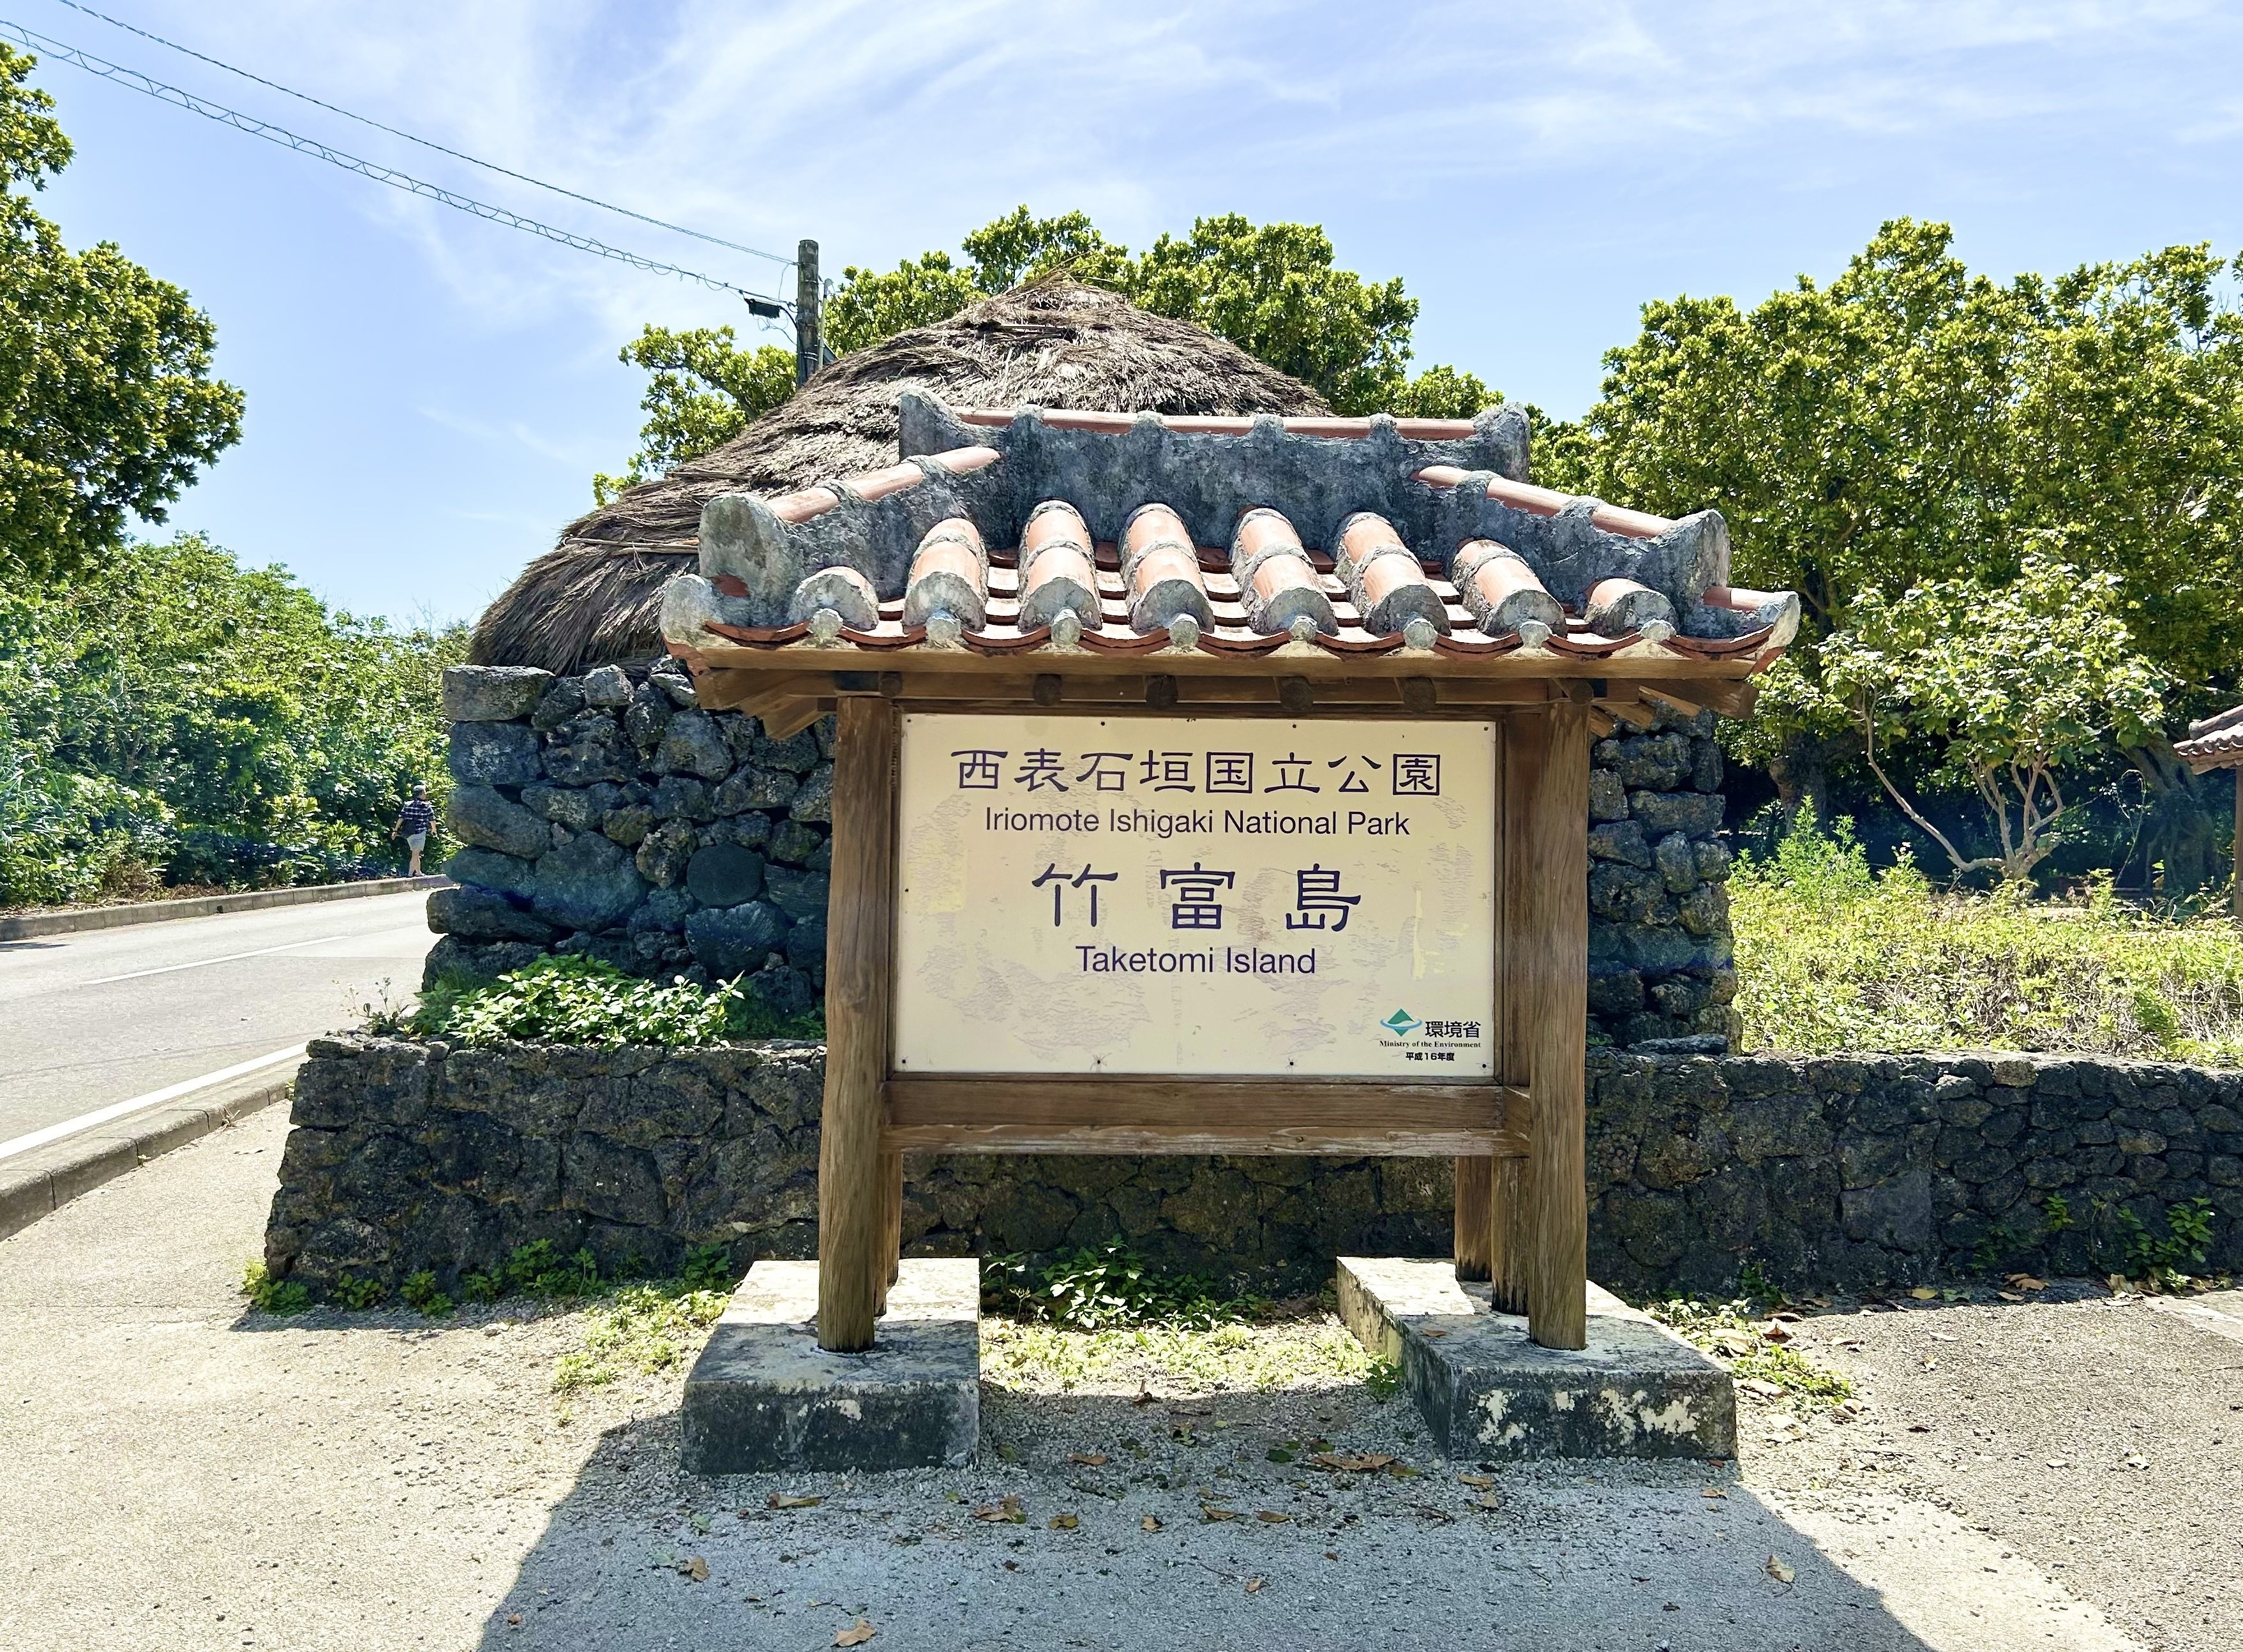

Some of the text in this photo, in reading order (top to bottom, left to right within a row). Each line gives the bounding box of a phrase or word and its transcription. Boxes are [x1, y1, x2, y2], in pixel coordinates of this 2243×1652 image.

[950, 747, 1441, 796] 西表石垣国立公園
[986, 807, 1410, 839] Iriomote Ishigaki National Park
[1031, 862, 1362, 932] 竹富島
[1076, 945, 1315, 974] Taketomi Island
[1425, 1021, 1481, 1039] 環境省
[1406, 1051, 1455, 1062] 平成16年度
